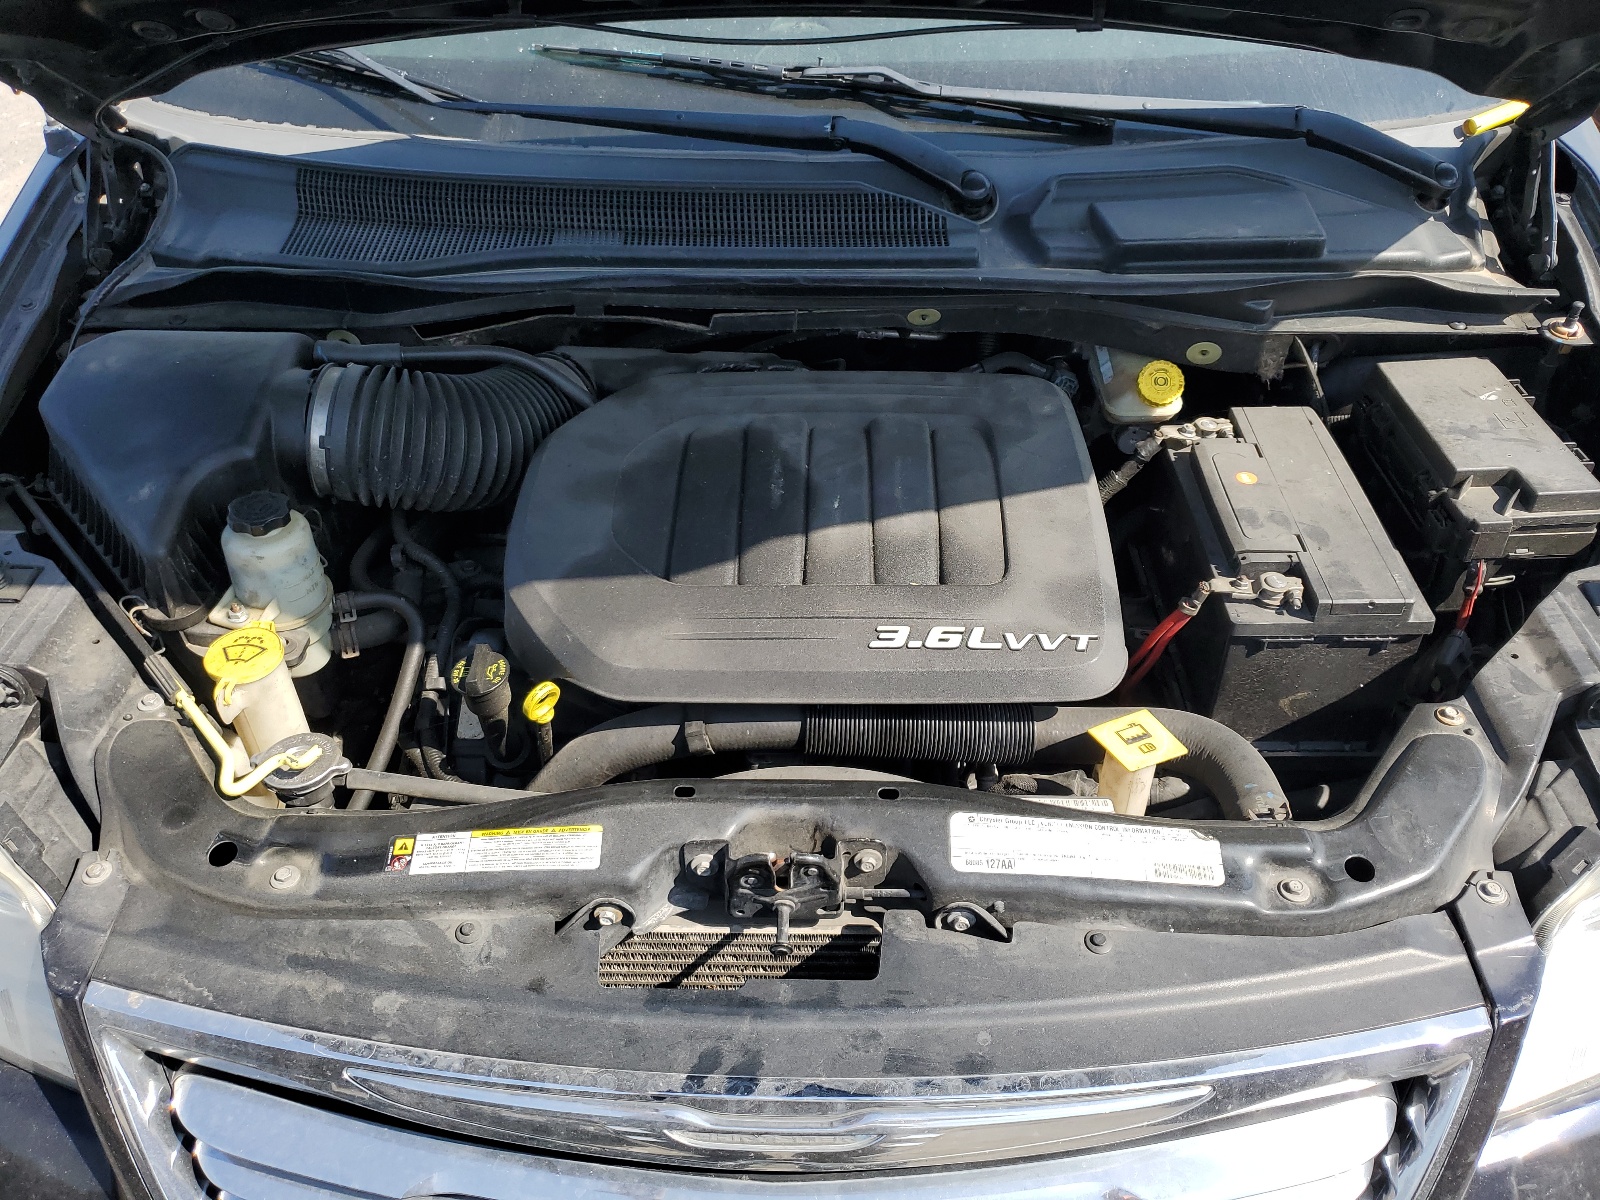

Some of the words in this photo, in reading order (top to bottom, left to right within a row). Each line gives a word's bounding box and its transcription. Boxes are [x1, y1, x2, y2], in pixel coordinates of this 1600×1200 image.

[979, 815, 1003, 824] Chrysler
[1004, 817, 1023, 826] Group
[1094, 824, 1120, 832] CONTROL
